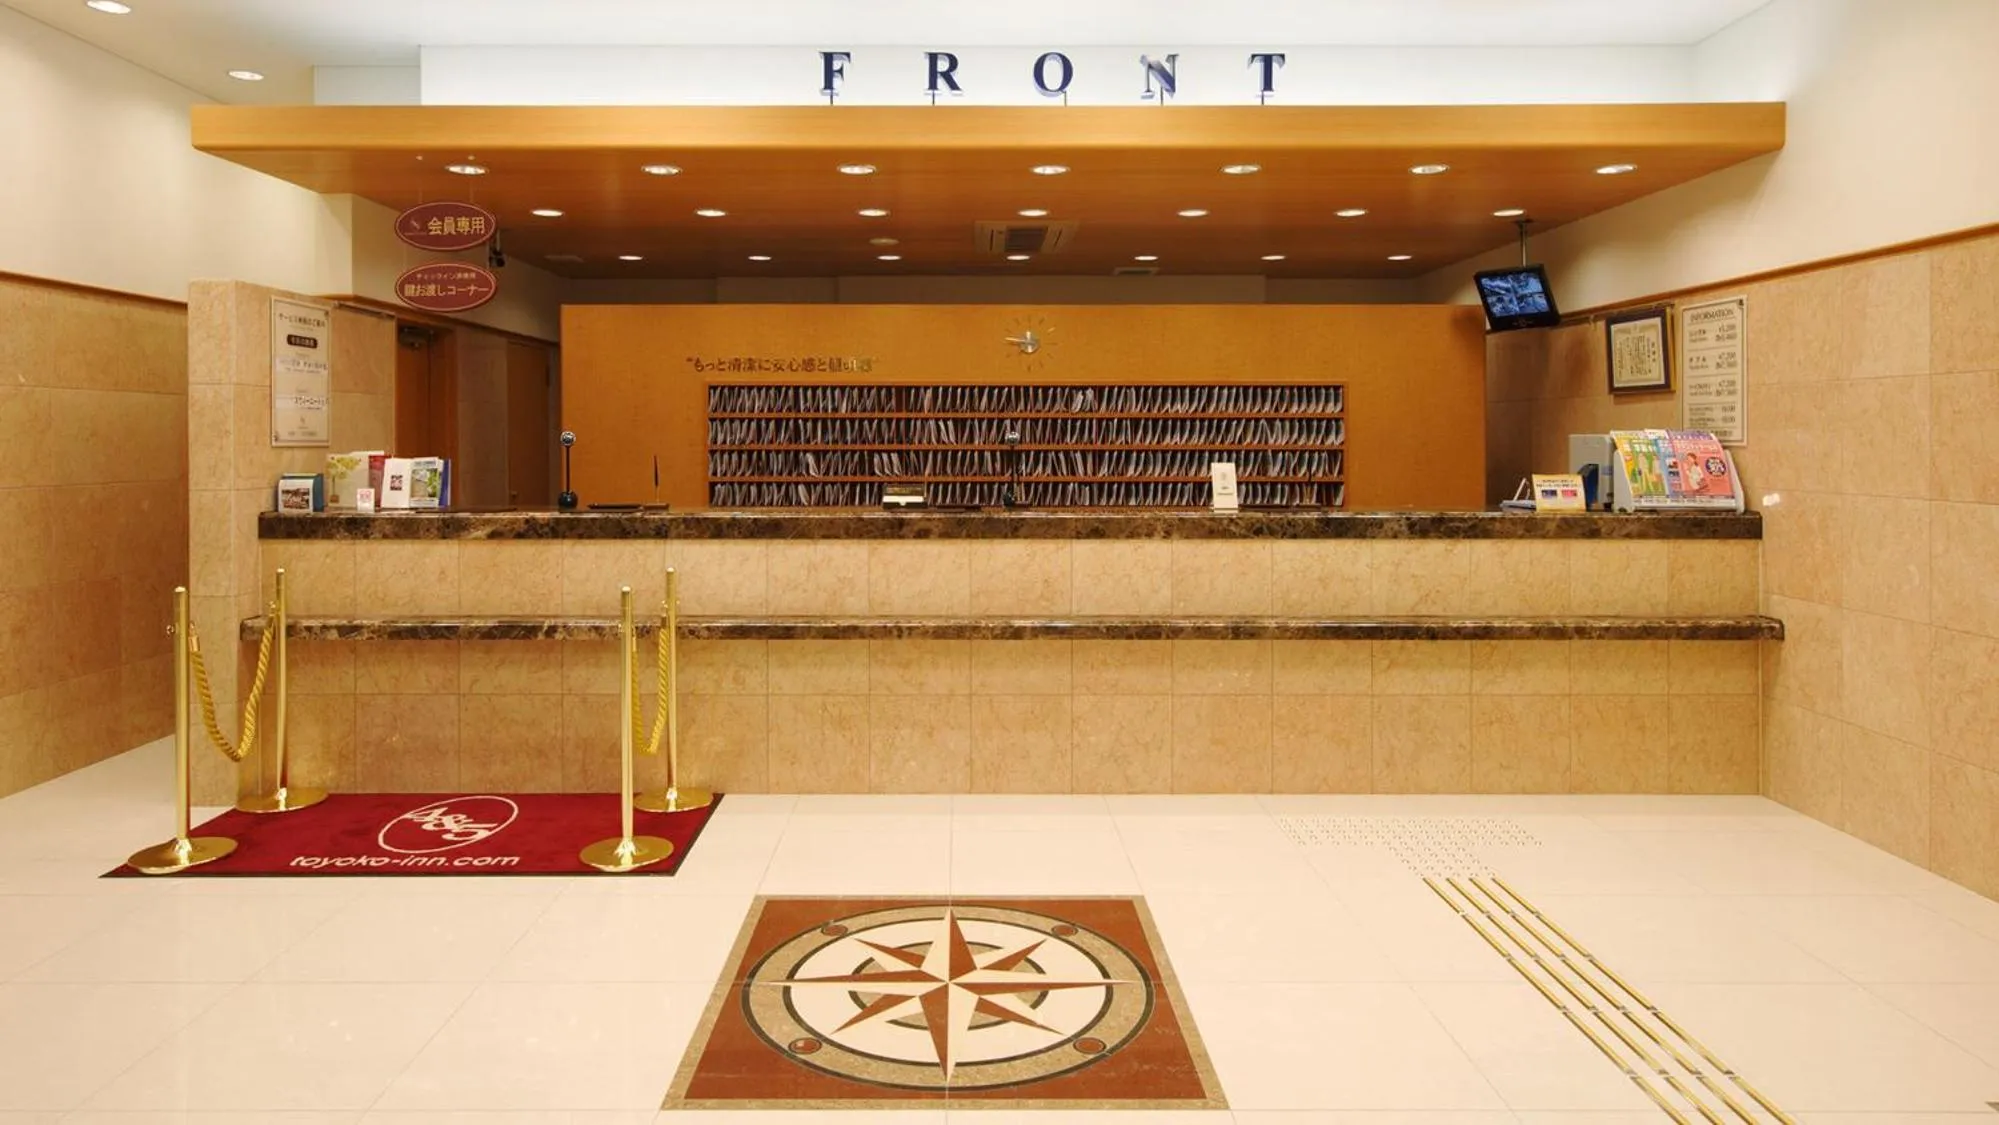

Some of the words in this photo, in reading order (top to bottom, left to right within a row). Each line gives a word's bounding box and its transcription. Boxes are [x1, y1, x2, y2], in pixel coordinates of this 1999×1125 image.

[820, 51, 1286, 97] FRONT
[427, 216, 485, 236] 会員専用
[1690, 308, 1734, 322] INFORMATION
[290, 855, 519, 869] toyoko-inn.com
